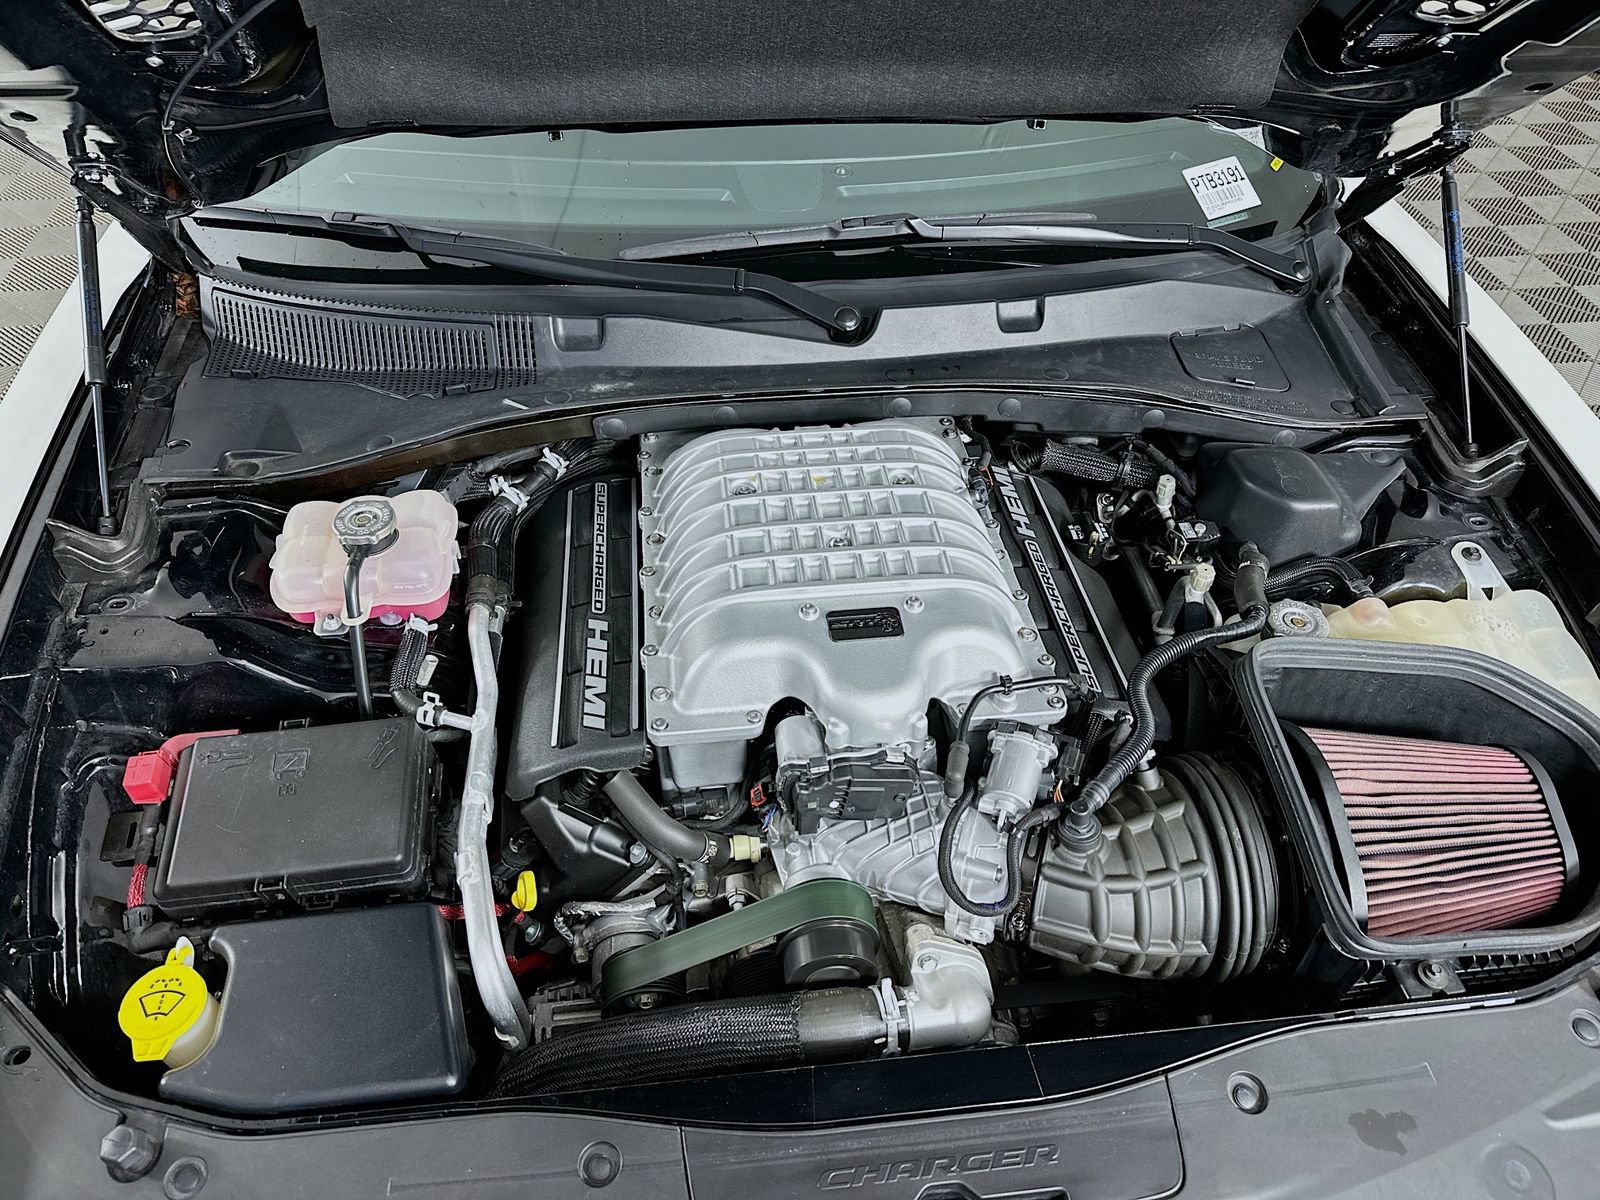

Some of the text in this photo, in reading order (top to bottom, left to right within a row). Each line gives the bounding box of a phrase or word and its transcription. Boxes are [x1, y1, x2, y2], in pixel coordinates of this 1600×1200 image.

[1190, 165, 1245, 193] PTB3191
[583, 483, 608, 731] SUPERCHARGED HEMI
[991, 465, 1099, 691] SUPERCHARGED HEMI
[816, 1142, 1061, 1191] CHARGER
